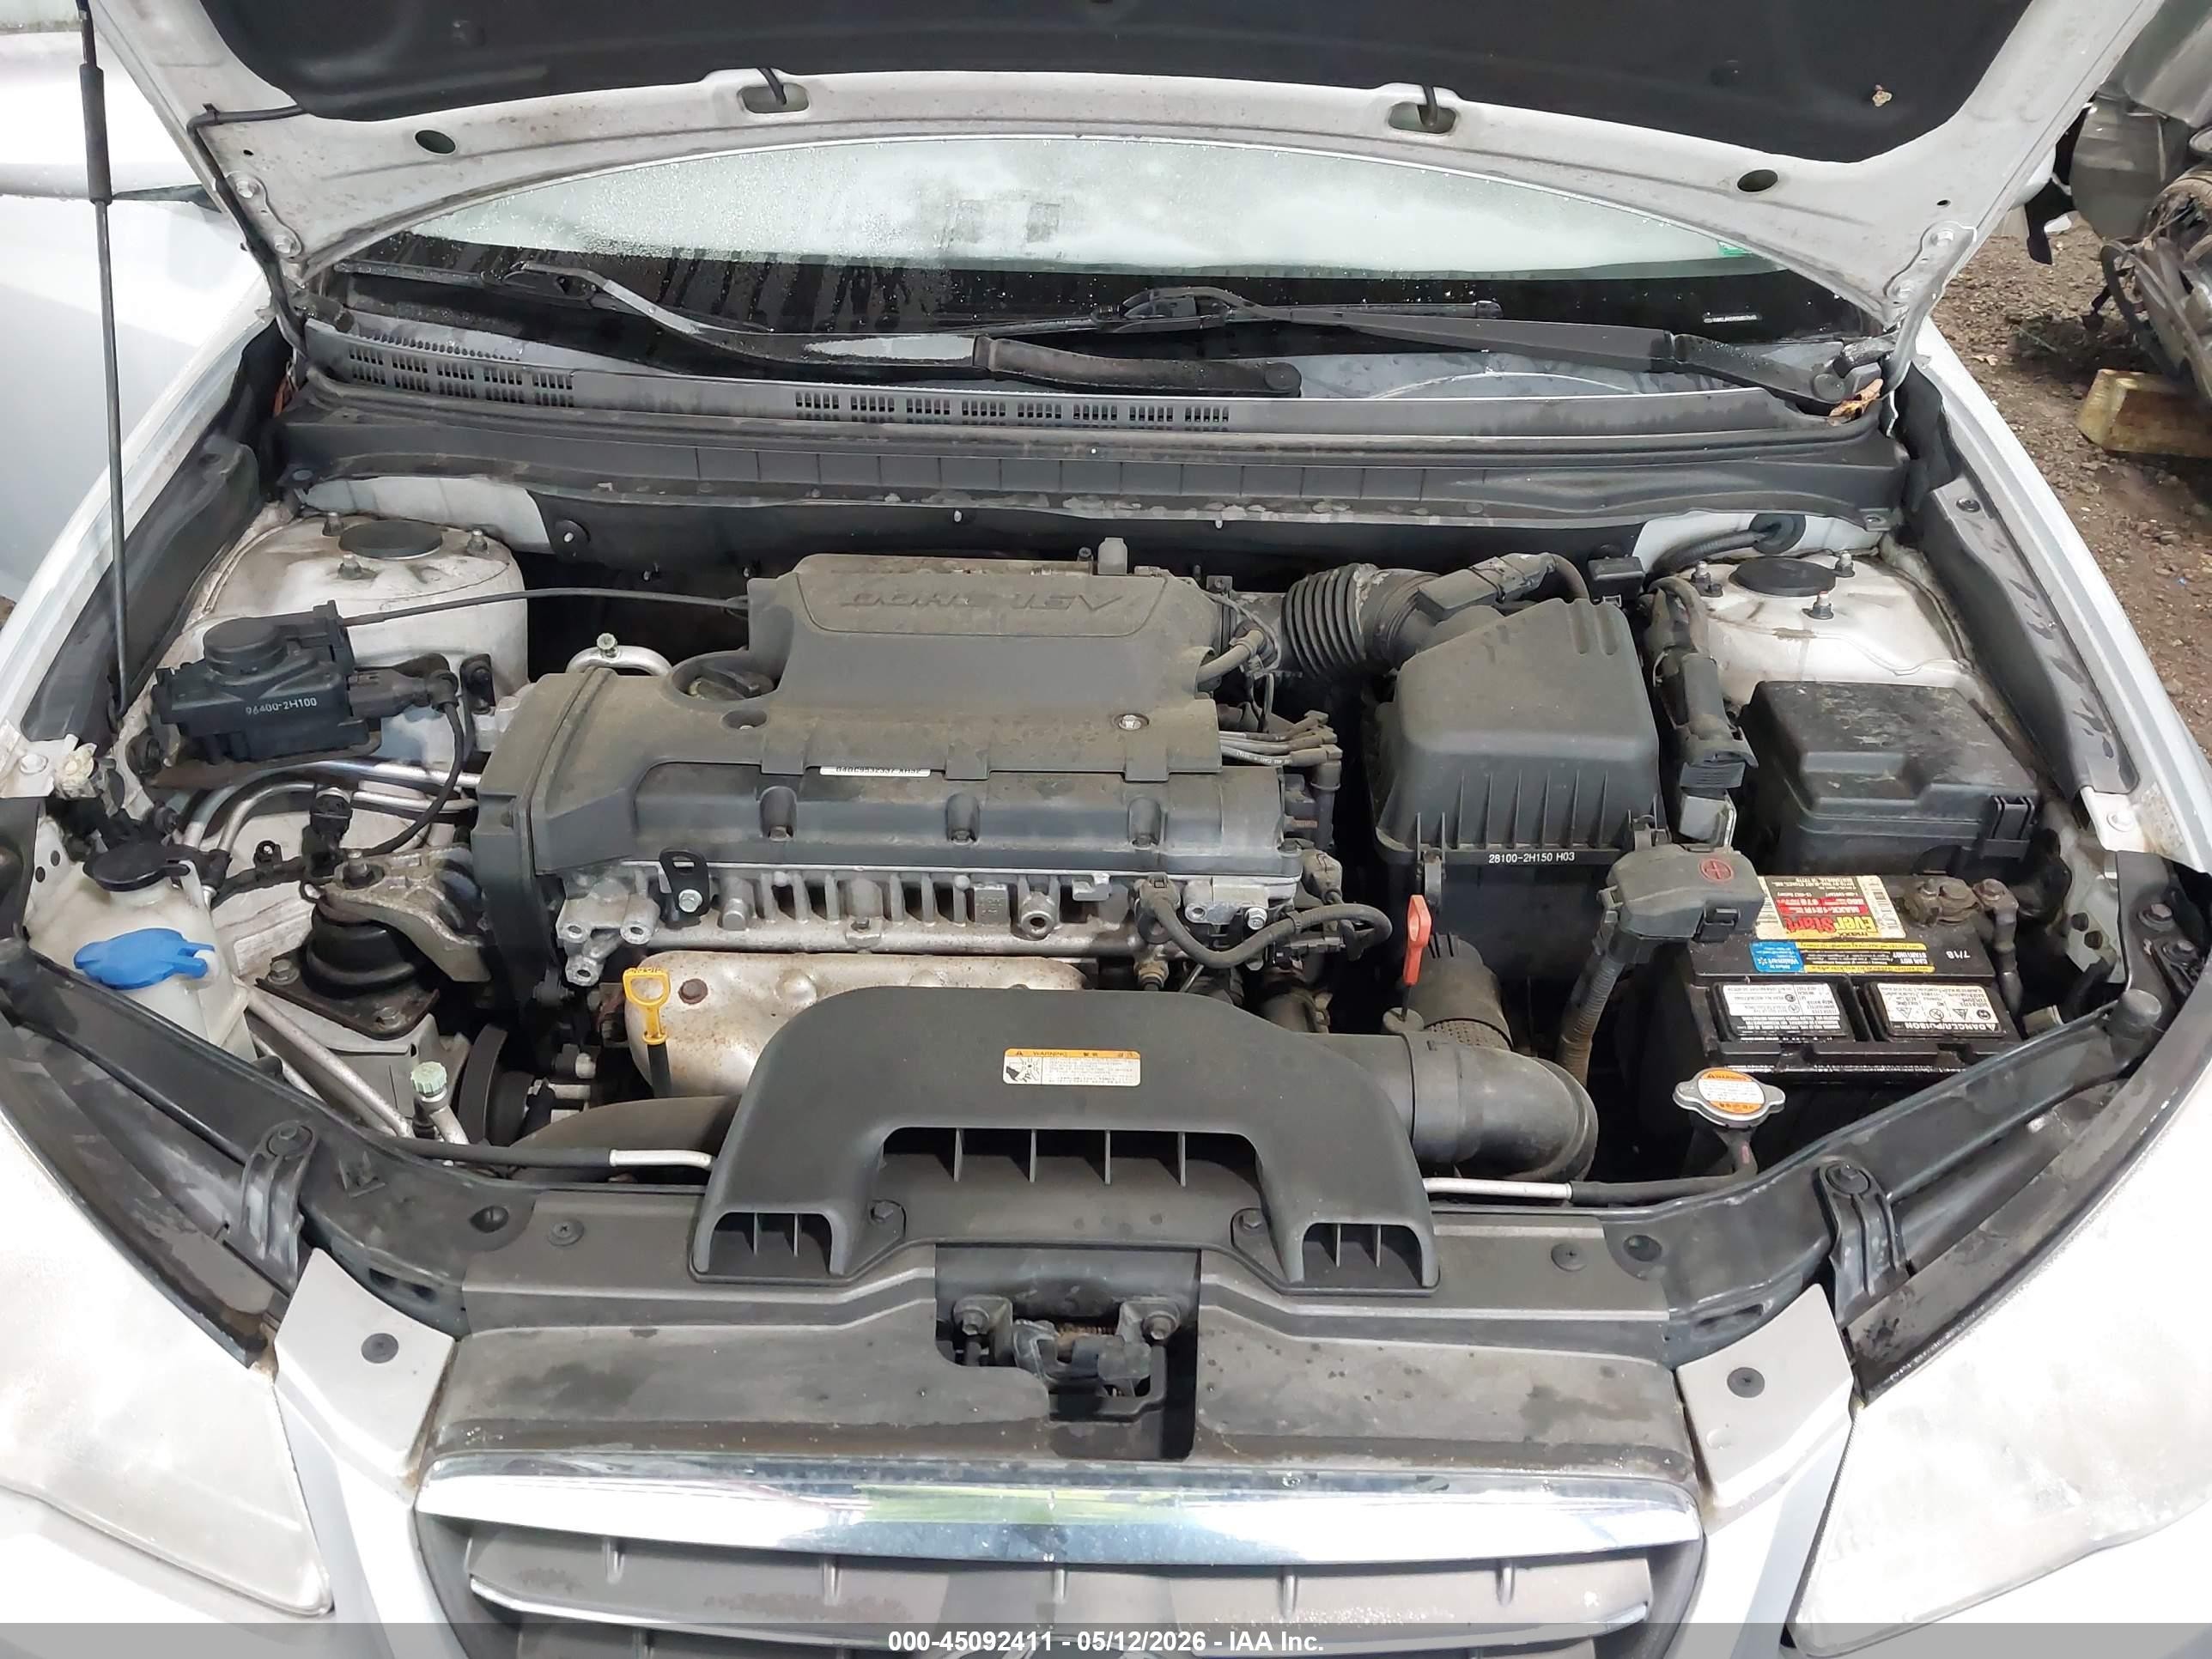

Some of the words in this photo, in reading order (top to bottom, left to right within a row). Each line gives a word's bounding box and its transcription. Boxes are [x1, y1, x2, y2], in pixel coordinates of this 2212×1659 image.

[246, 697, 317, 714] 96400-2H100
[1488, 853, 1553, 863] 28100-2H150
[1556, 851, 1575, 861] H03
